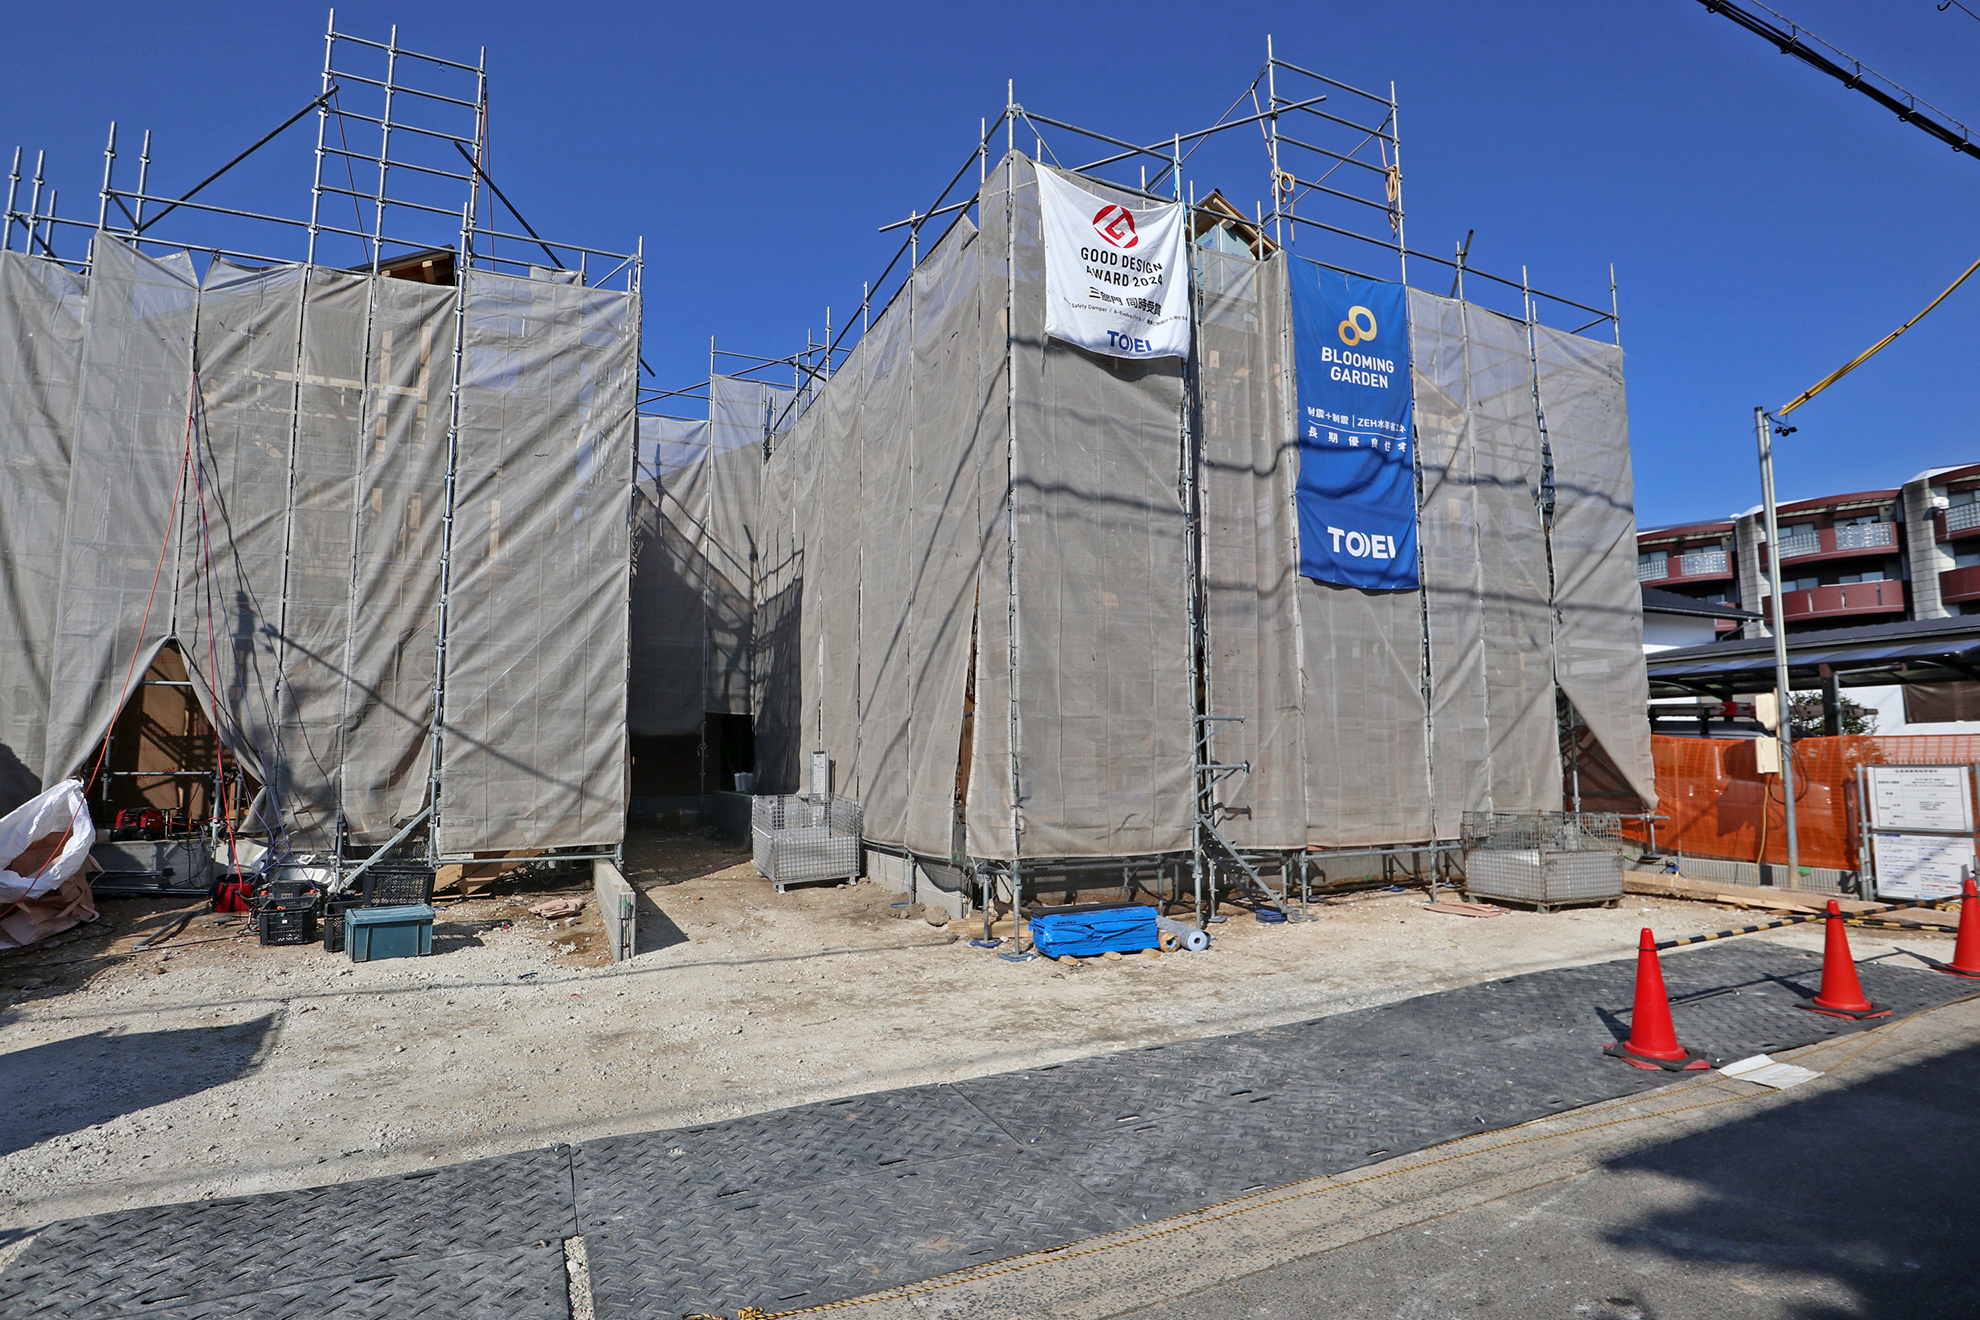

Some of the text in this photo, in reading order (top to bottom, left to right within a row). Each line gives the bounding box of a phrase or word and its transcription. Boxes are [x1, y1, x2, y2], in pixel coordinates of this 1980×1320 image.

[1080, 246, 1163, 274] GOOD DESIGN
[1086, 265, 1163, 287] AWARD 2024
[1071, 302, 1087, 310] Safety
[1088, 304, 1107, 312] Damper
[1088, 286, 1123, 306] 三部門
[1126, 297, 1162, 317] 同時受賞
[1106, 330, 1153, 353] TOEI
[1321, 346, 1395, 373] BLOOMING
[1330, 366, 1389, 389] GARDEN
[1326, 525, 1397, 559] TOEI
